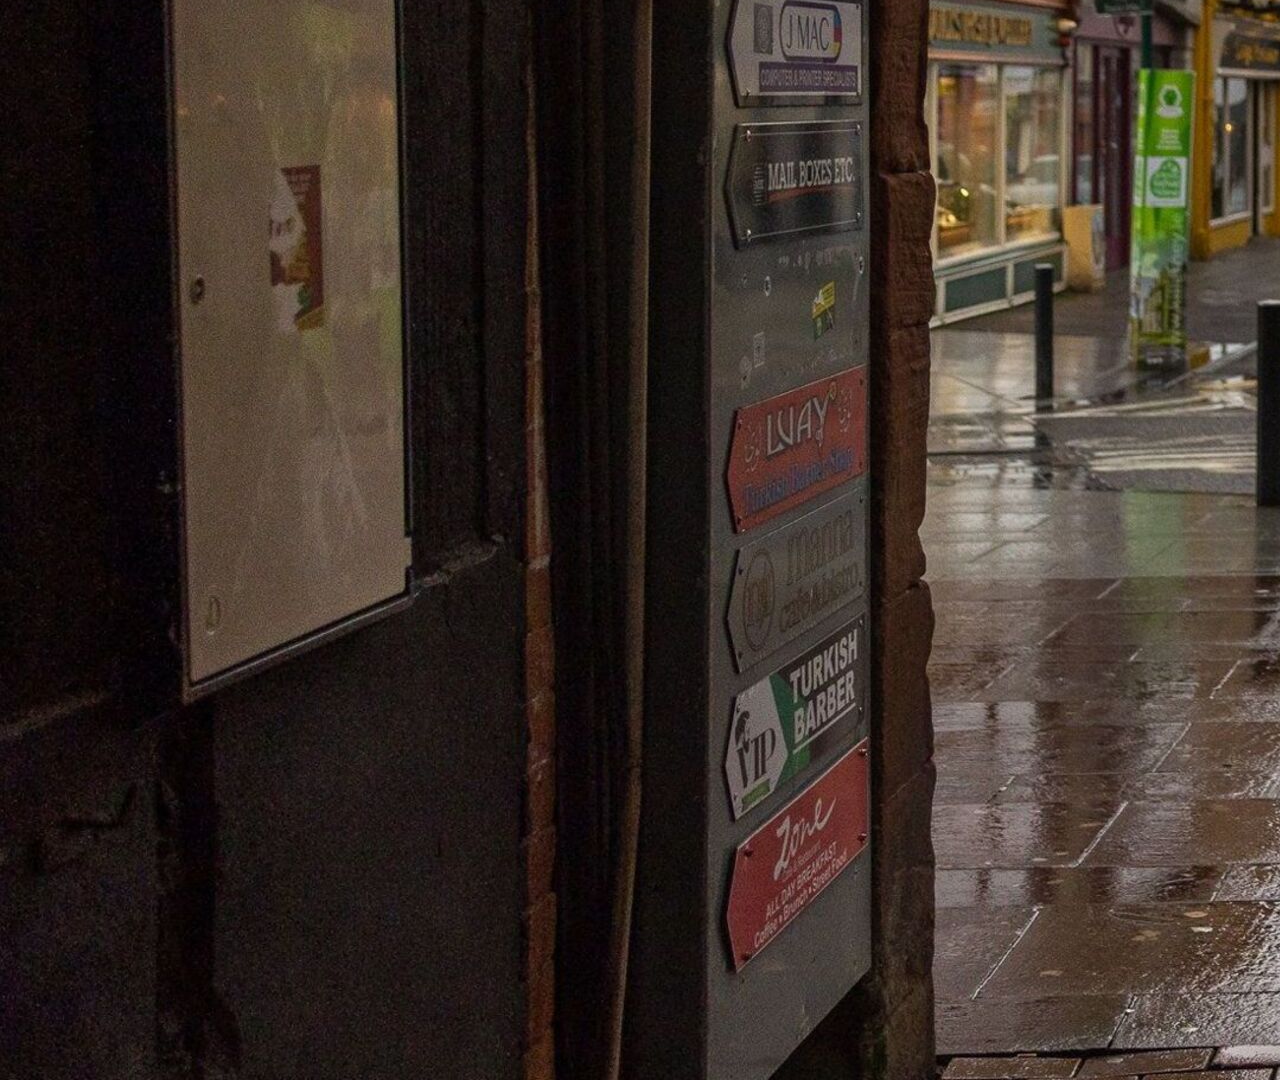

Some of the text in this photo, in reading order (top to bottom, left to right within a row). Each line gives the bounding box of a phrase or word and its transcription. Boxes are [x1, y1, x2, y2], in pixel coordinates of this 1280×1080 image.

[797, 15, 830, 51] MAC
[760, 68, 793, 87] COMPUTER
[799, 69, 823, 88] PRINTER
[823, 70, 857, 89] SPECIALISTS
[767, 161, 797, 192] MAIL
[799, 158, 833, 187] BOXES
[834, 156, 856, 183] ETC.
[789, 629, 858, 704] TURKISH
[793, 669, 856, 743] BARBER
[736, 726, 777, 790] VIP
[773, 795, 837, 882] Zone
[754, 847, 848, 949] Coffee Brunch Street Food
[765, 840, 838, 920] ALL DAY BREAKFAST
